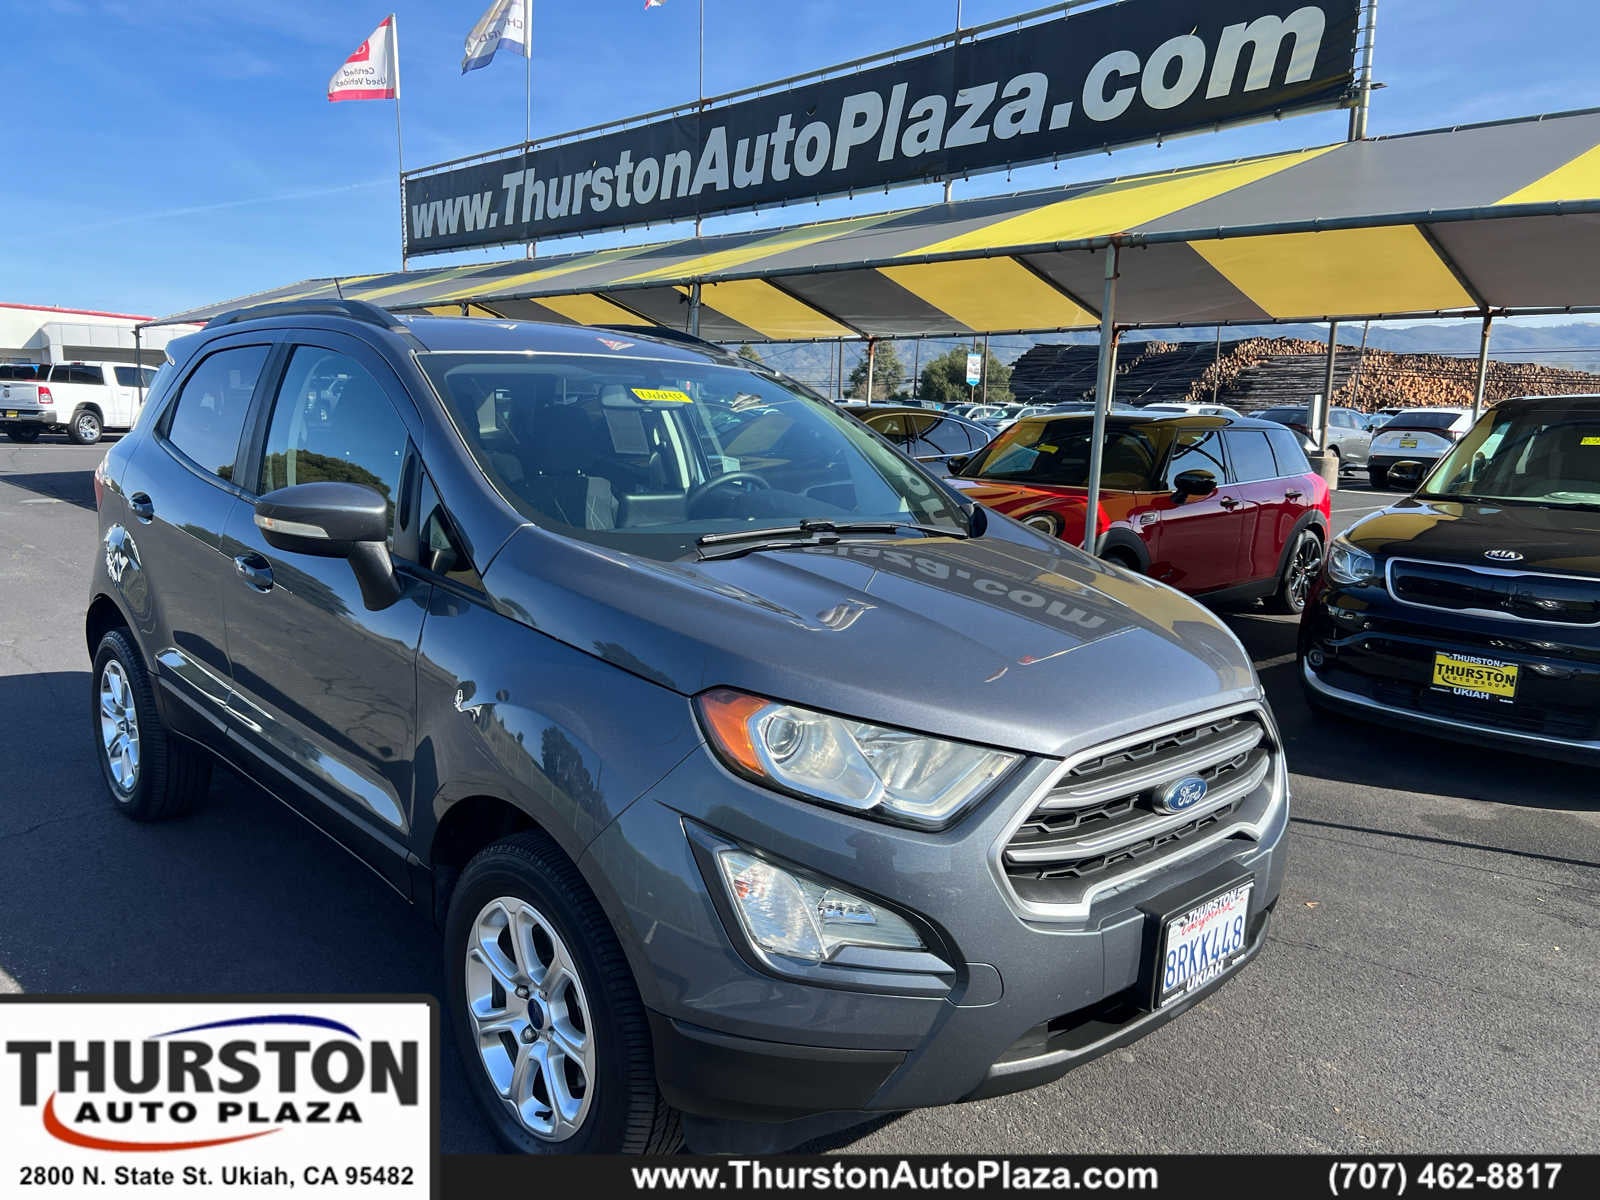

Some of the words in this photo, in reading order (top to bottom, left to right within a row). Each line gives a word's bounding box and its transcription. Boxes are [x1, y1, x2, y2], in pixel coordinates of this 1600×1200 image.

[411, 5, 1326, 240] www.ThurstonAutoPlaza.com
[1452, 653, 1500, 667] THURSTON
[1436, 663, 1515, 687] THURSTON
[1453, 687, 1490, 700] UKIAH
[1178, 783, 1201, 806] Ford
[1188, 888, 1239, 922] THURSTON
[1165, 914, 1243, 988] 8RKK448
[1187, 960, 1224, 992] UKIAH
